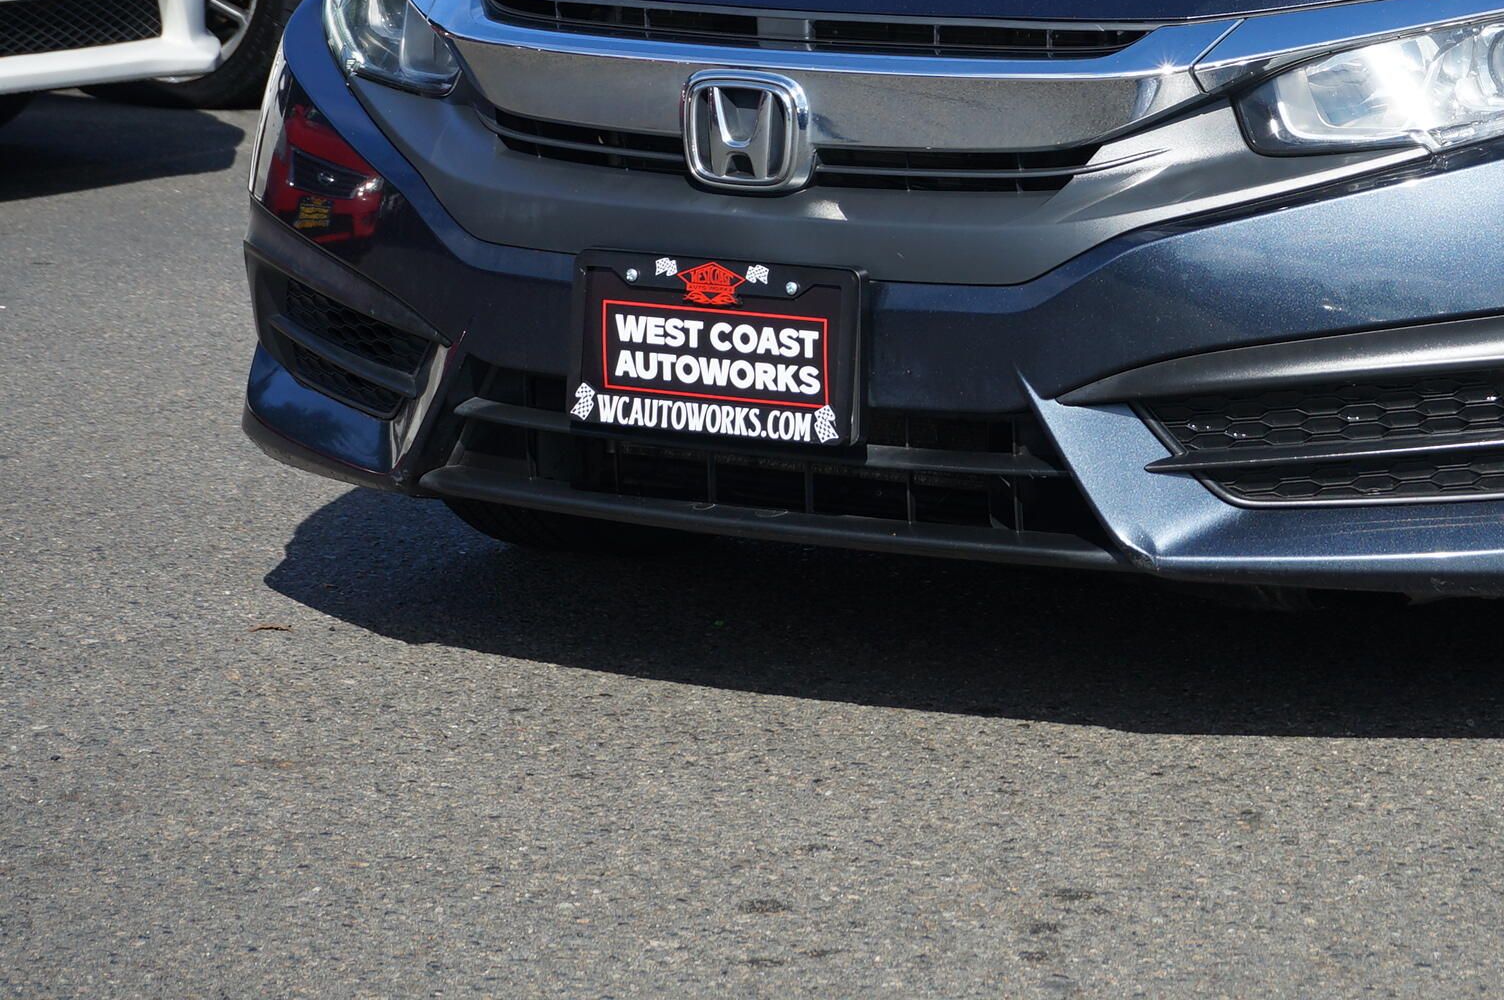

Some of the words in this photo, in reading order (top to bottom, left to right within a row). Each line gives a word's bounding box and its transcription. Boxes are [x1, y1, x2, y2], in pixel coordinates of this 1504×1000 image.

[615, 314, 704, 349] WEST
[709, 322, 819, 359] COAST
[615, 350, 821, 395] AUTOWORKS
[597, 394, 812, 442] WCAUTOWORKS.COM
